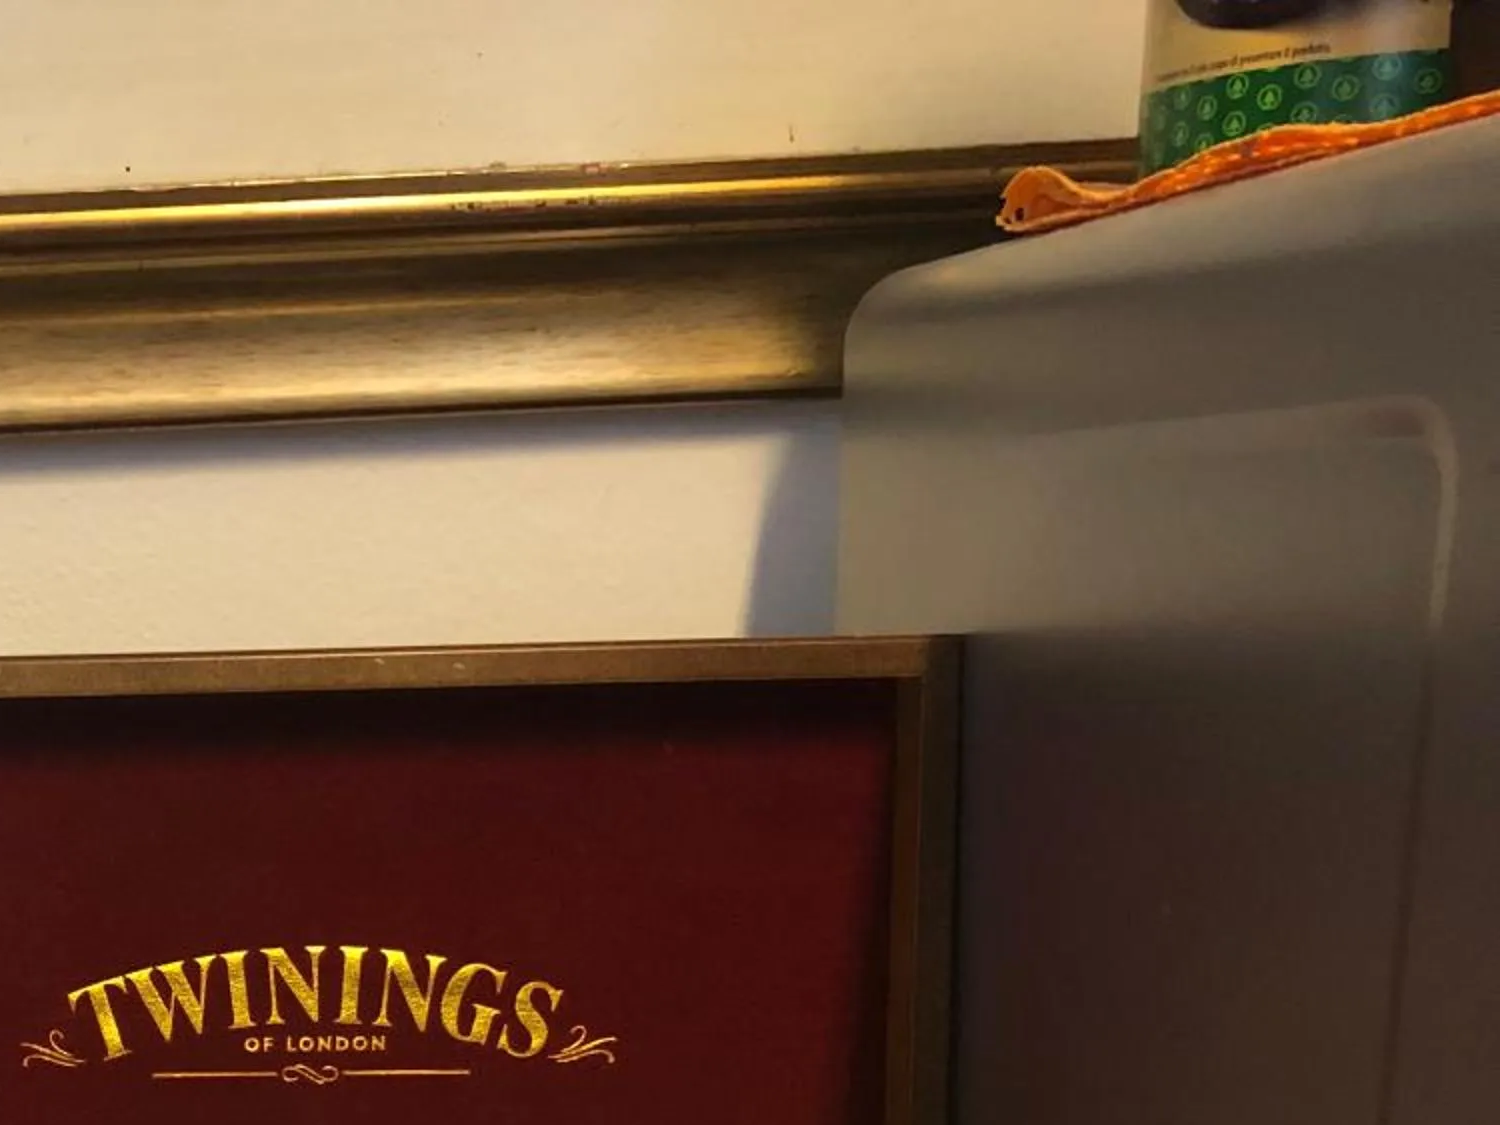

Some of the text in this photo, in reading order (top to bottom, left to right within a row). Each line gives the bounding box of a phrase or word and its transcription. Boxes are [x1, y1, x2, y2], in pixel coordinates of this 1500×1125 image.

[67, 945, 564, 1061] TWININGS
[243, 1035, 387, 1053] OF LONDON
